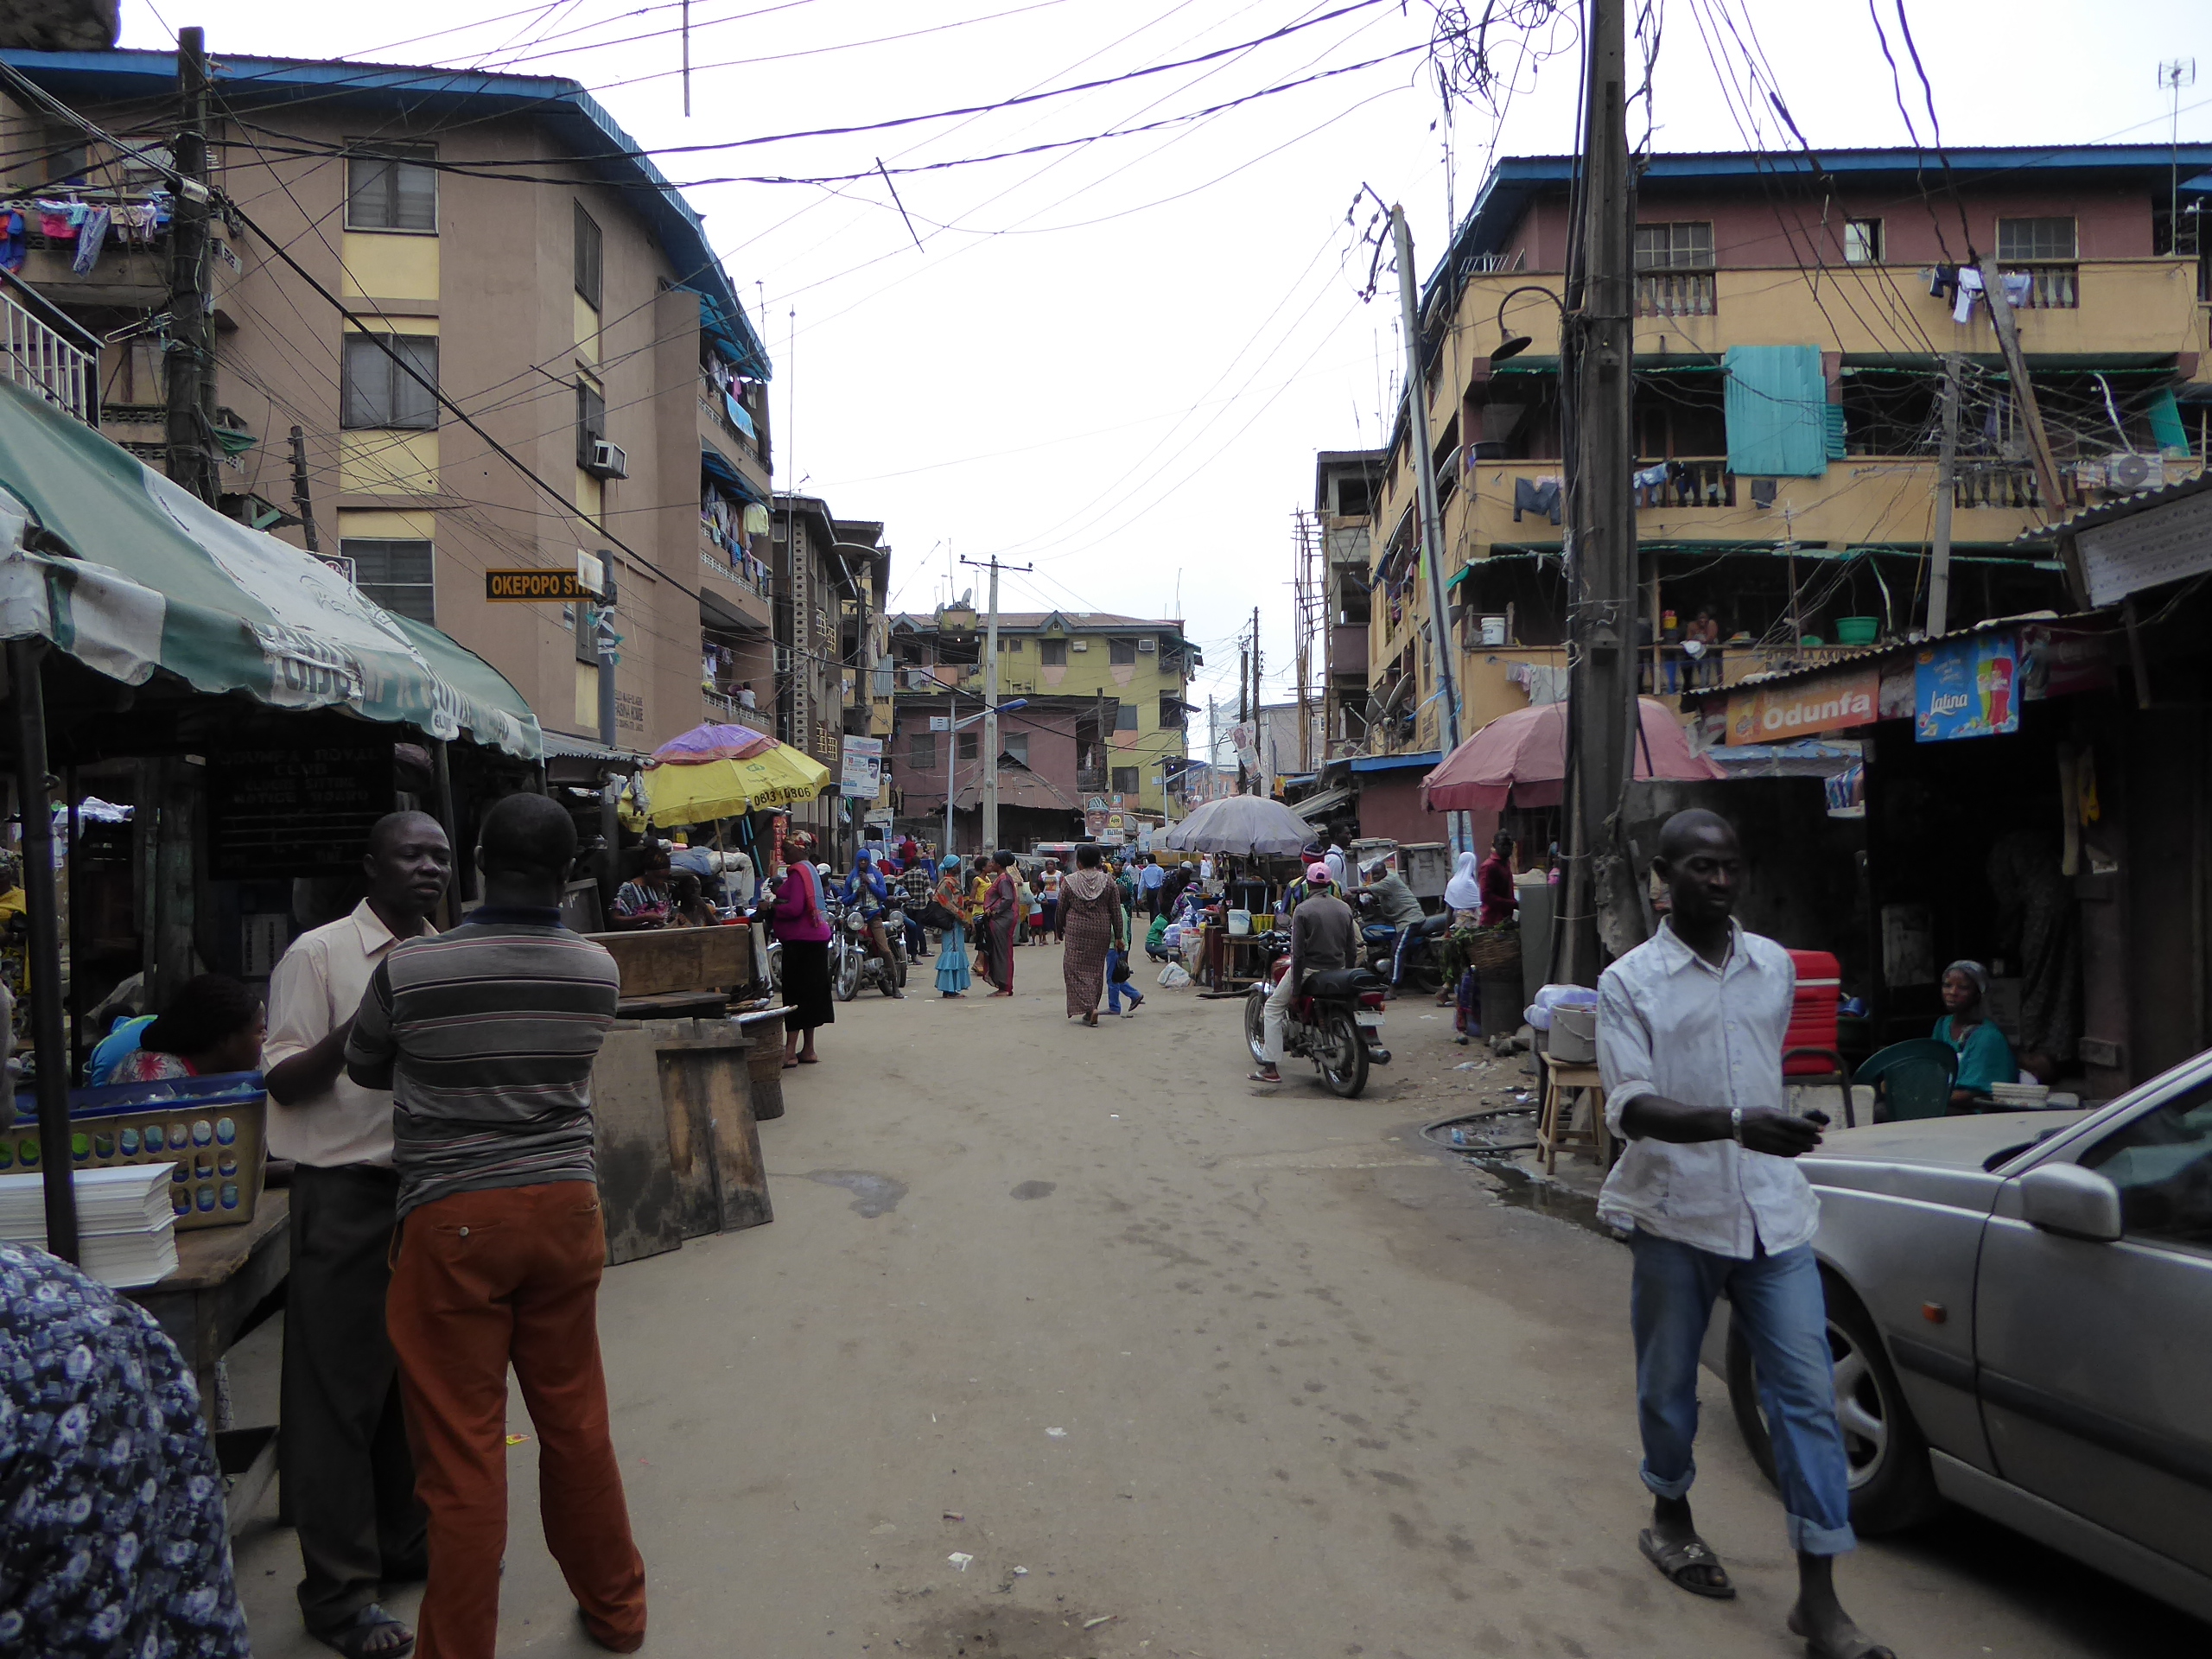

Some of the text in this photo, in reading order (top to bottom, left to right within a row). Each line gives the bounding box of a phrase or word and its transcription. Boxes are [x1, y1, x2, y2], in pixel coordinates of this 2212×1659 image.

[492, 575, 560, 595] OKEPOPO
[1764, 691, 1870, 730] Odunfa
[1930, 690, 1968, 716] Latina
[314, 747, 379, 762] ROYAL
[274, 763, 328, 776] CLUB
[304, 777, 356, 790] SITTING
[233, 790, 370, 804] NOTICE BOARD
